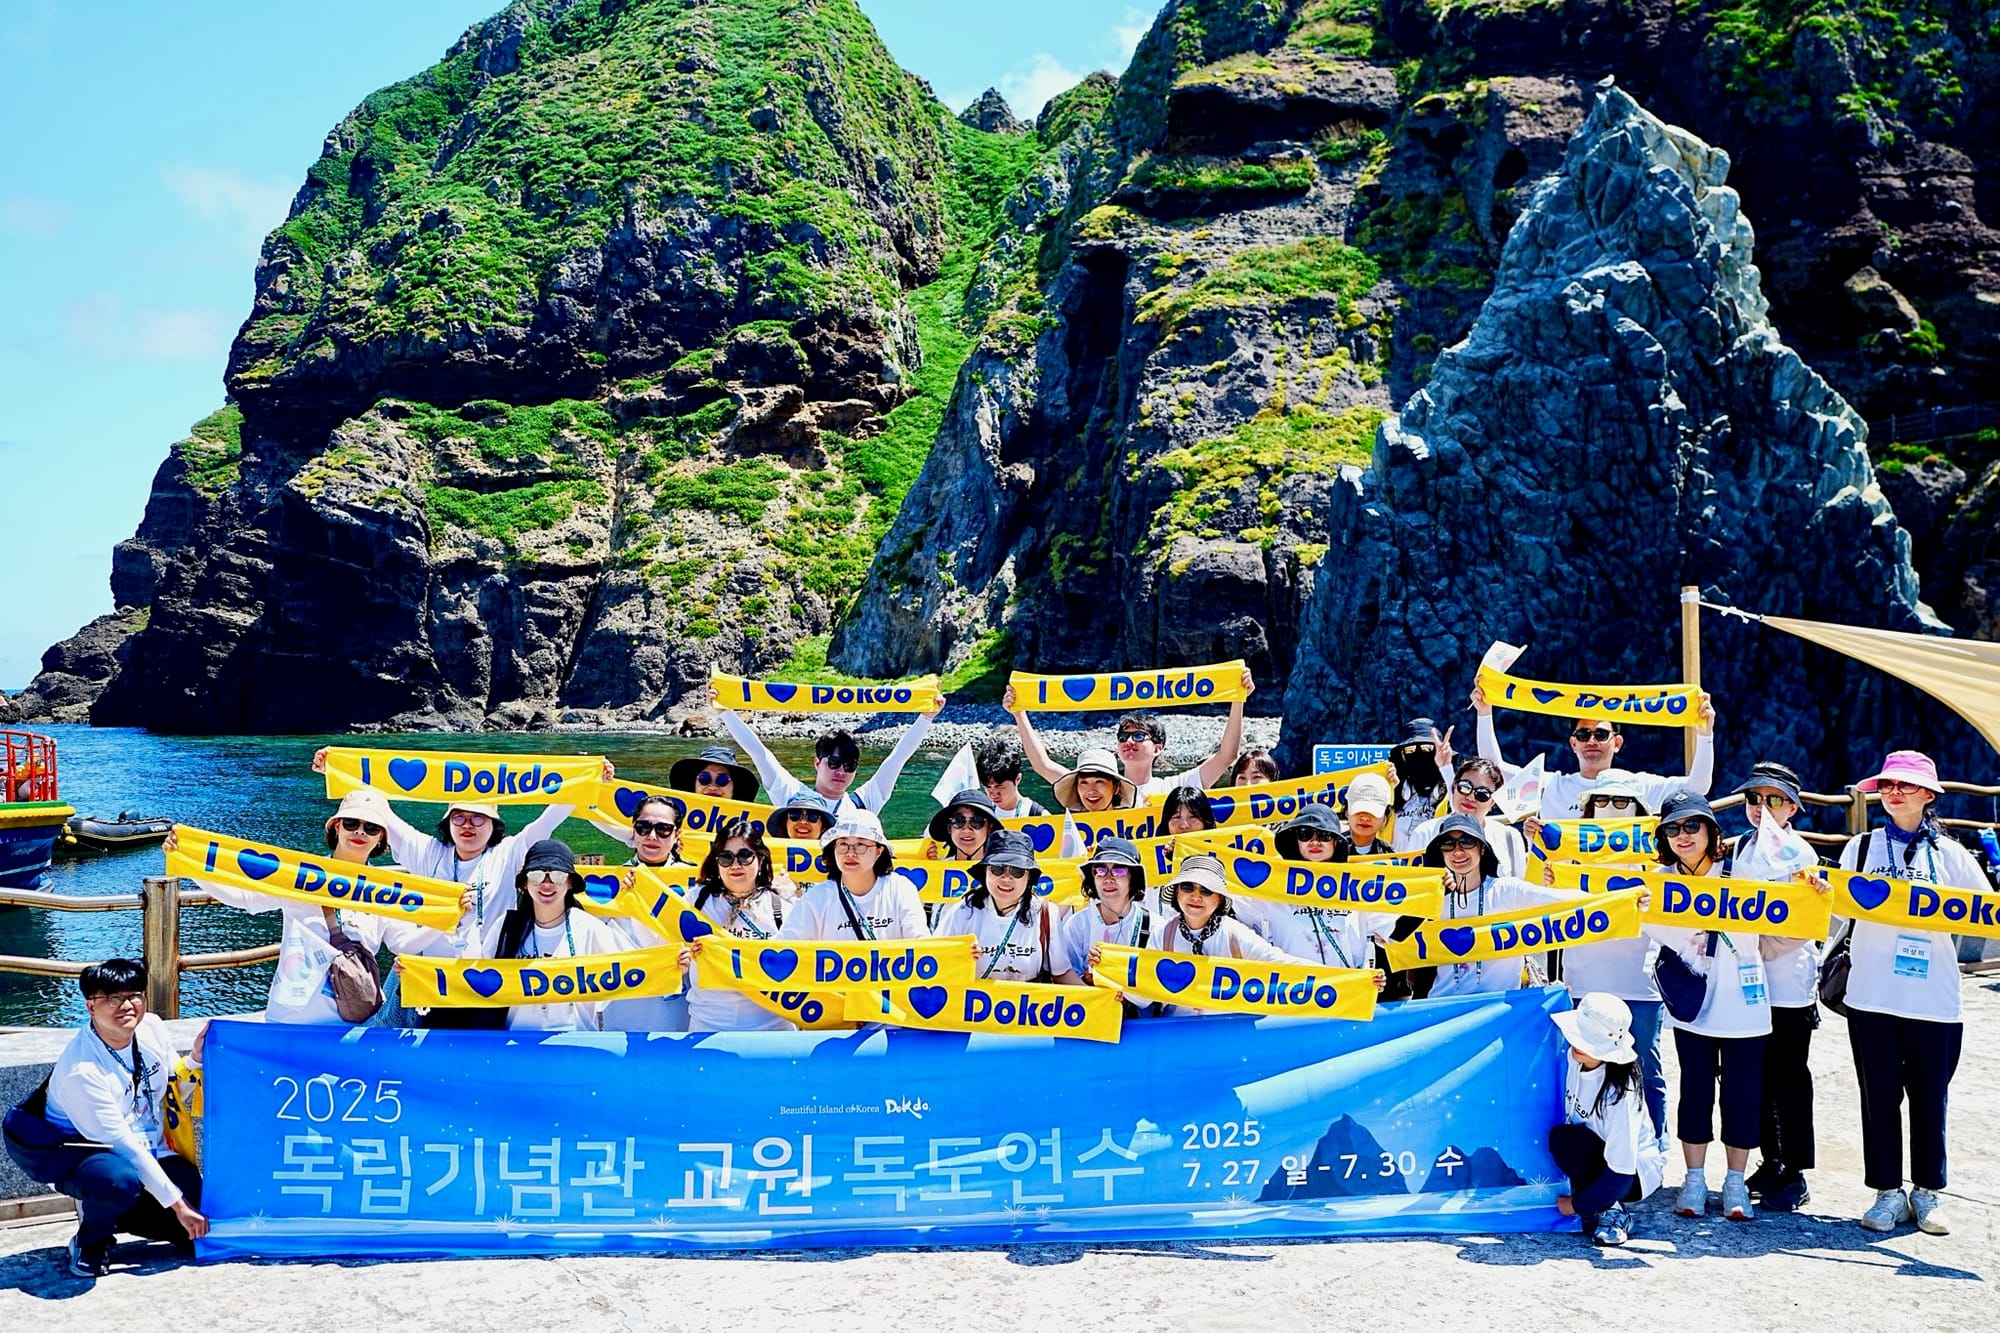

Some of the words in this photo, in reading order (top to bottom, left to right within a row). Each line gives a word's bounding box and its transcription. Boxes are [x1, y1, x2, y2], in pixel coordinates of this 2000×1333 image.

[742, 681, 751, 702] I
[811, 686, 912, 704] Dokdo
[1039, 680, 1047, 703] I
[1110, 673, 1215, 701] Dokdo
[1505, 683, 1516, 699] I
[1575, 691, 1688, 715] Dokdo
[361, 757, 371, 785] I
[444, 761, 563, 794] Dokdo
[1319, 750, 1391, 768] 독도이사부
[1531, 843, 1548, 861] I
[1579, 823, 1658, 854] Dok
[204, 841, 219, 872] I
[294, 862, 424, 912] Dokdo
[1286, 867, 1407, 905] Dokdo
[1662, 881, 1789, 924] Dokdo
[1908, 885, 2000, 925] Dok
[1415, 932, 1427, 959] I
[1491, 907, 1610, 952] Dokdo
[435, 968, 447, 996] I
[519, 962, 646, 996] Dokdo
[731, 949, 742, 978] I
[815, 948, 938, 982] Dokdo
[1127, 955, 1139, 987] I
[1210, 966, 1338, 1008] Dokdo
[881, 989, 891, 1014] I
[963, 989, 1086, 1027] Dokdo
[273, 1076, 403, 1123] 2025
[780, 1105, 817, 1115] Beautiful
[818, 1105, 844, 1114] Island
[855, 1105, 880, 1114] Korea
[1182, 1120, 1261, 1150] 2025
[272, 1135, 647, 1217] 독립기념관
[664, 1134, 814, 1216] 교원
[843, 1127, 1145, 1212] 독도연수
[1435, 1145, 1464, 1178] 수
